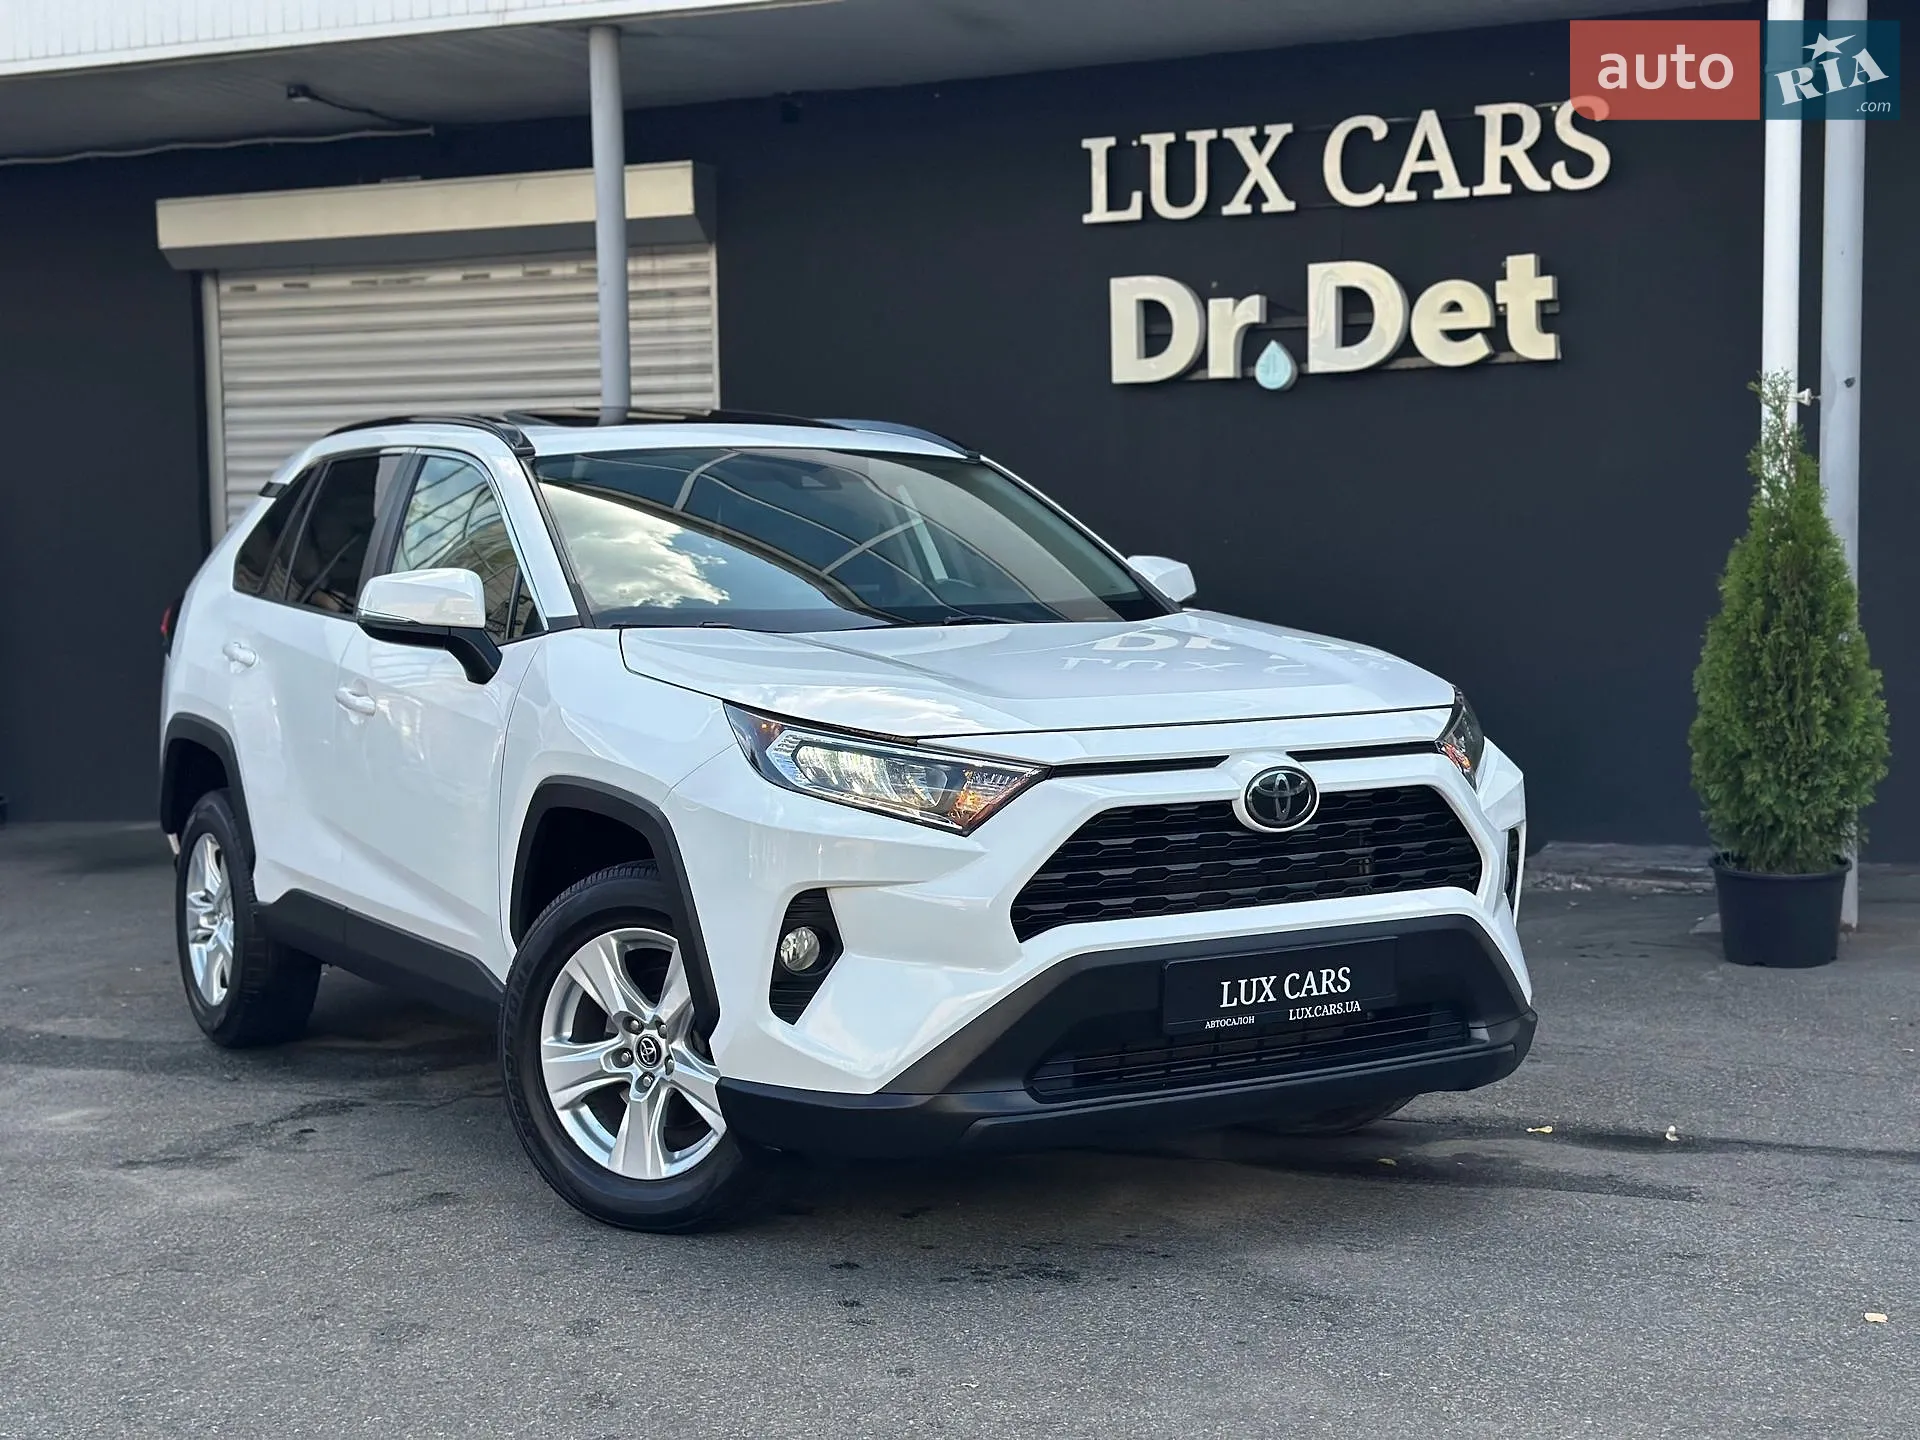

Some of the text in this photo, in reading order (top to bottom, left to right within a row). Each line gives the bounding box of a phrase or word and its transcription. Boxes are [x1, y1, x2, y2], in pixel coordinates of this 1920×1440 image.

[1081, 95, 1611, 224] LUX CARS
[1220, 966, 1351, 1008] LUX CARS
[1204, 1015, 1255, 1029] АВТОСАЛОН
[1288, 1000, 1362, 1021] LUX.CARS.UA
